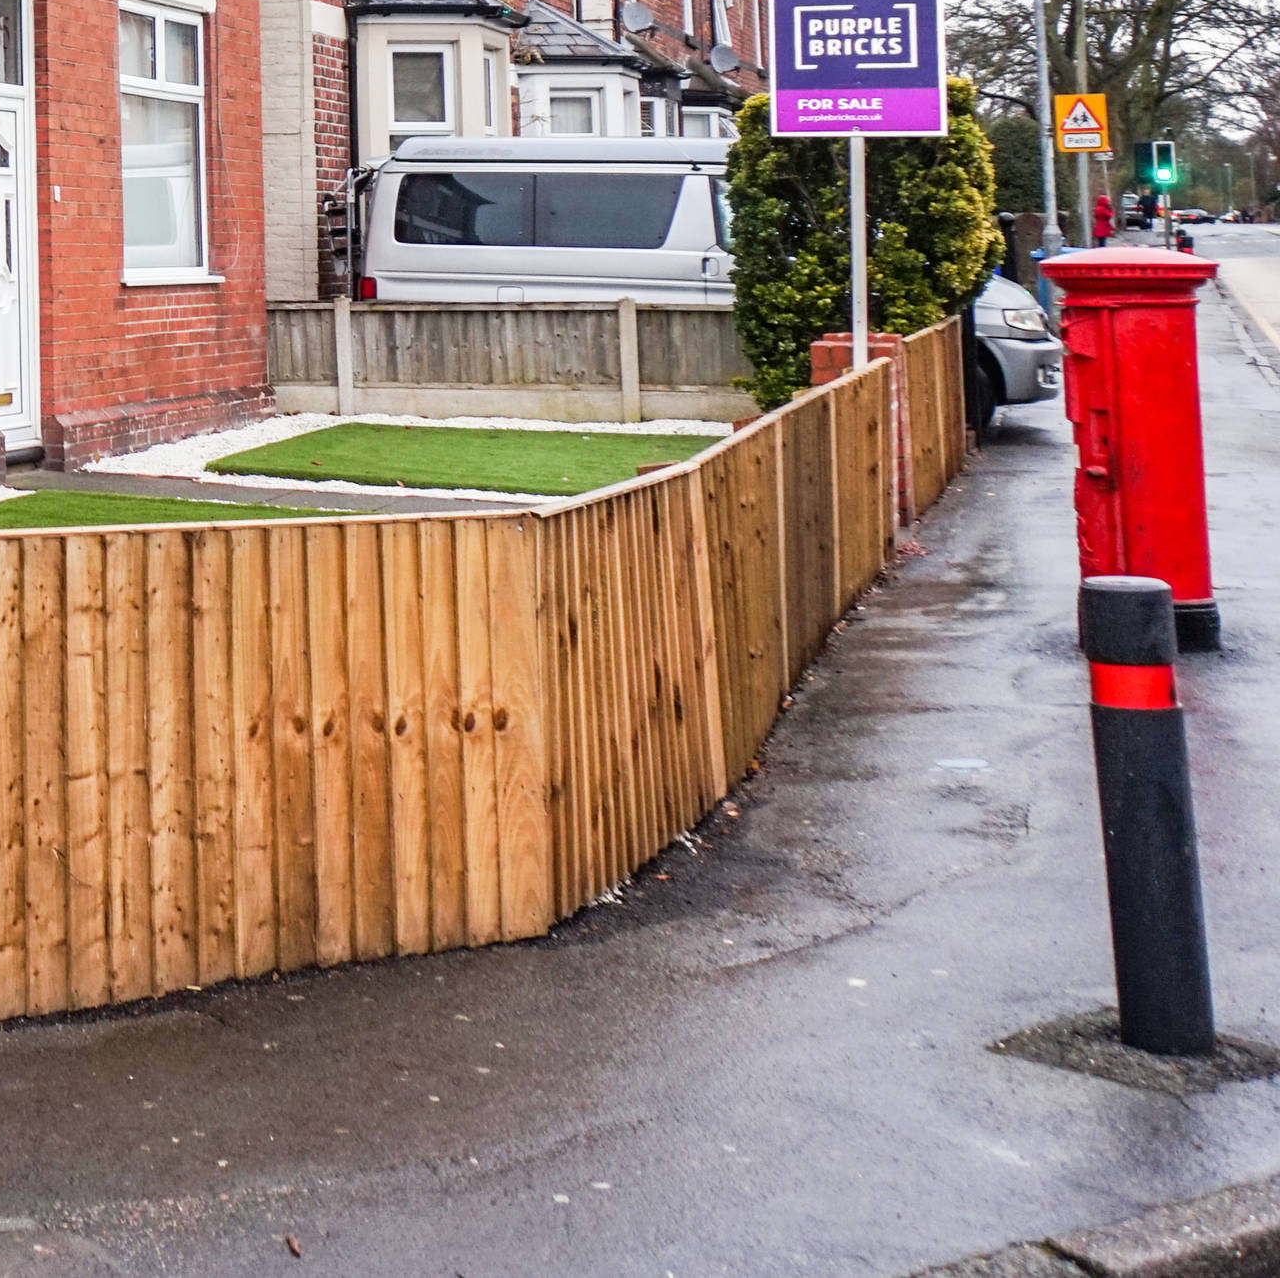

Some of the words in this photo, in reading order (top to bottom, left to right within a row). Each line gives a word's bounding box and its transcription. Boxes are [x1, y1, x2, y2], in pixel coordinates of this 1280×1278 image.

[808, 17, 903, 36] PURPLE
[808, 37, 903, 56] BRICKS
[797, 98, 834, 110] FOR
[837, 97, 883, 110] SALE
